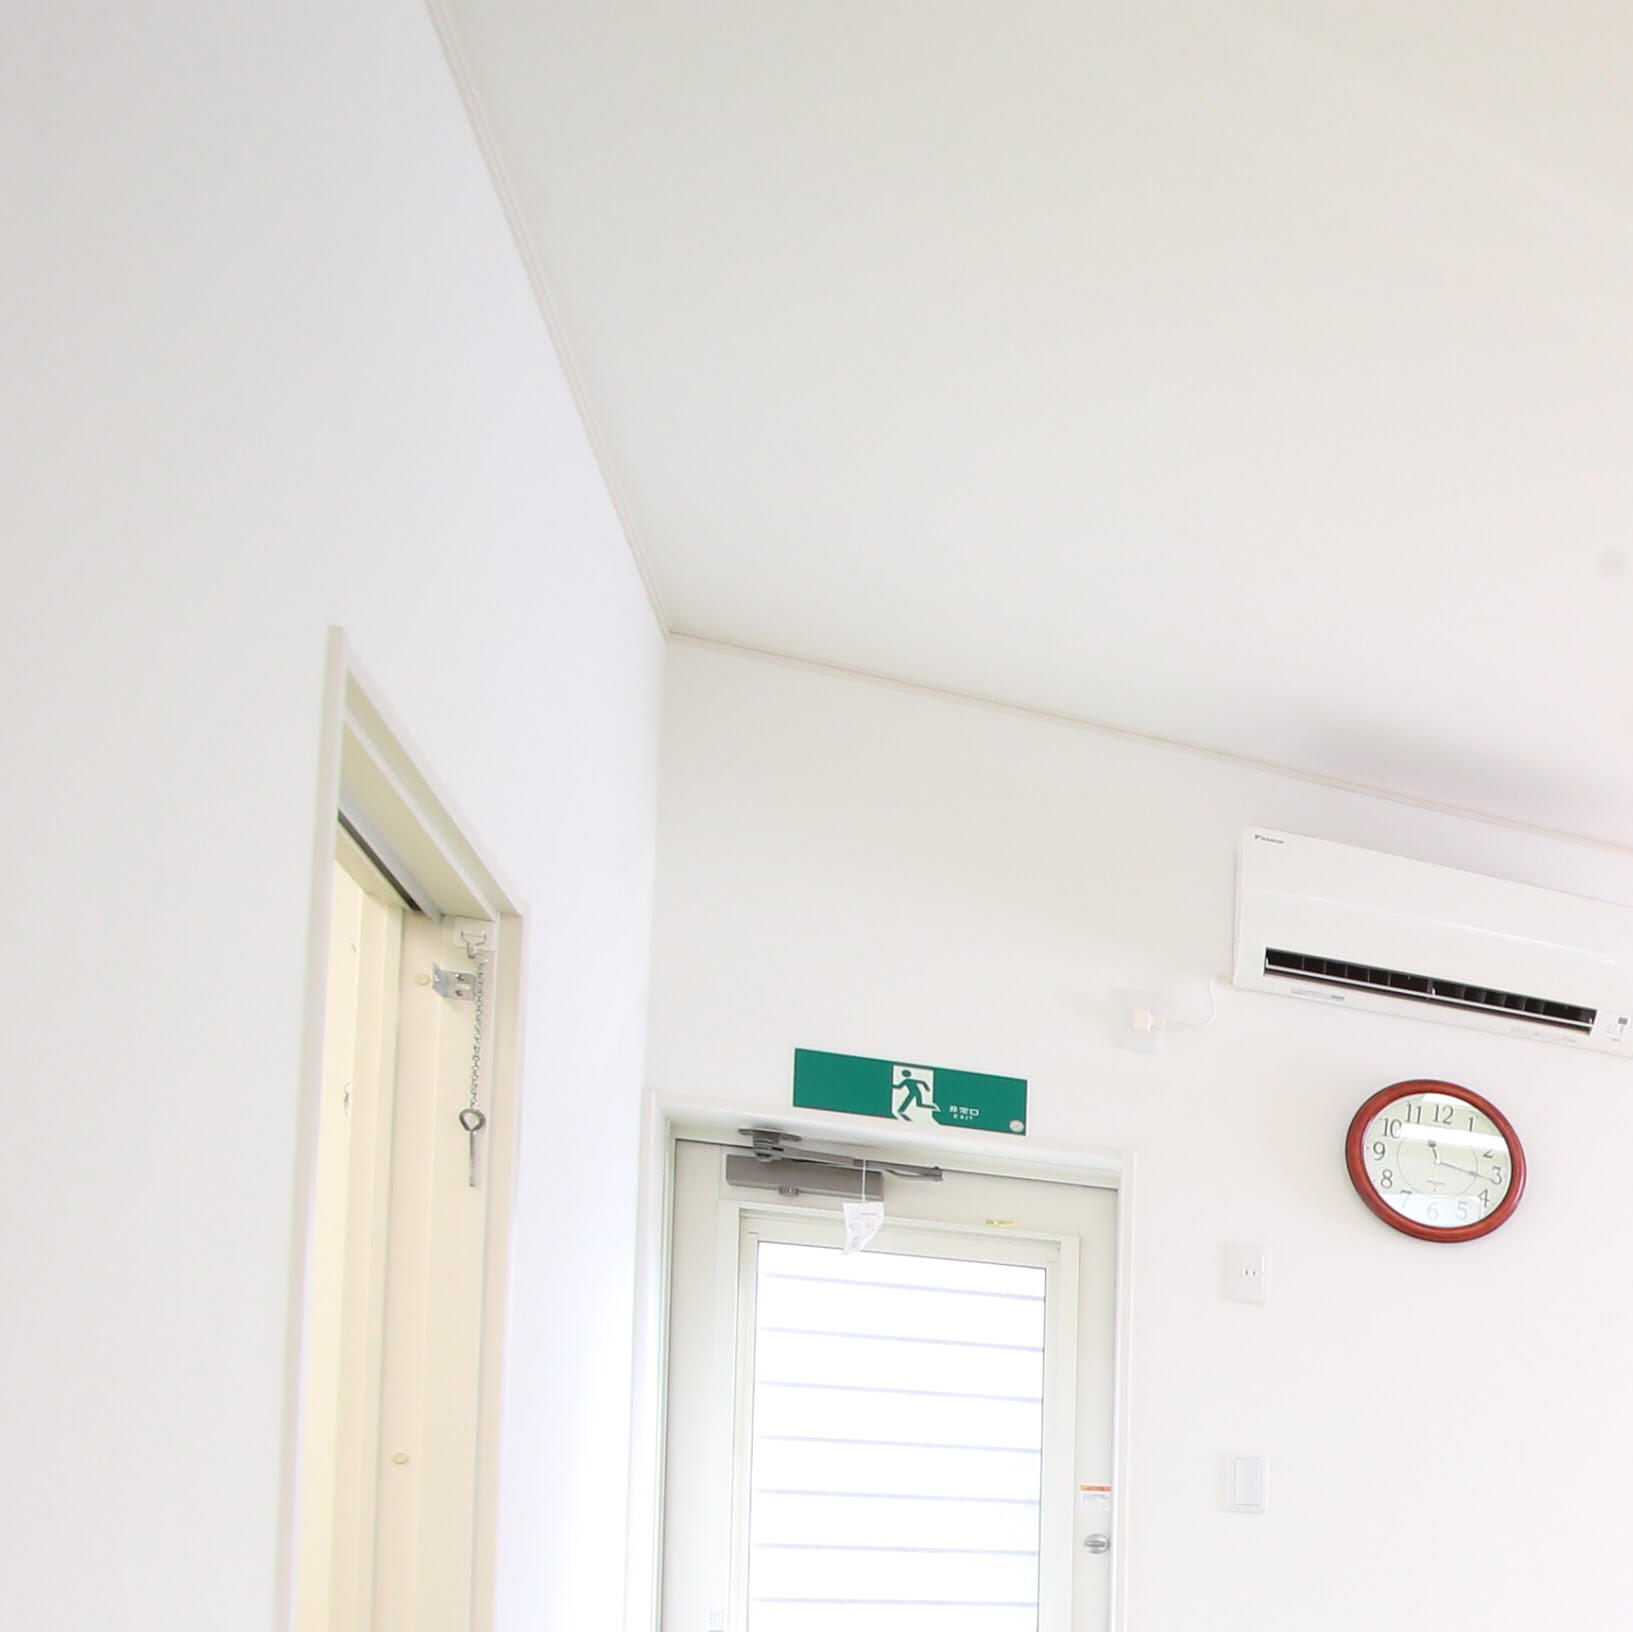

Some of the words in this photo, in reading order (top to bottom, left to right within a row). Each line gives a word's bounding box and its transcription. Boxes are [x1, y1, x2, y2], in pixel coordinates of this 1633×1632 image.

[1406, 1100, 1422, 1125] 11
[1433, 1104, 1454, 1125] 12
[1382, 1118, 1402, 1139] 10
[1373, 1141, 1386, 1161] 9
[1380, 1169, 1393, 1189] 8
[1491, 1165, 1503, 1185] 3
[1400, 1189, 1413, 1209] 7
[1478, 1188, 1490, 1208] 4
[1427, 1202, 1439, 1221] 6
[1456, 1201, 1468, 1220] 5
